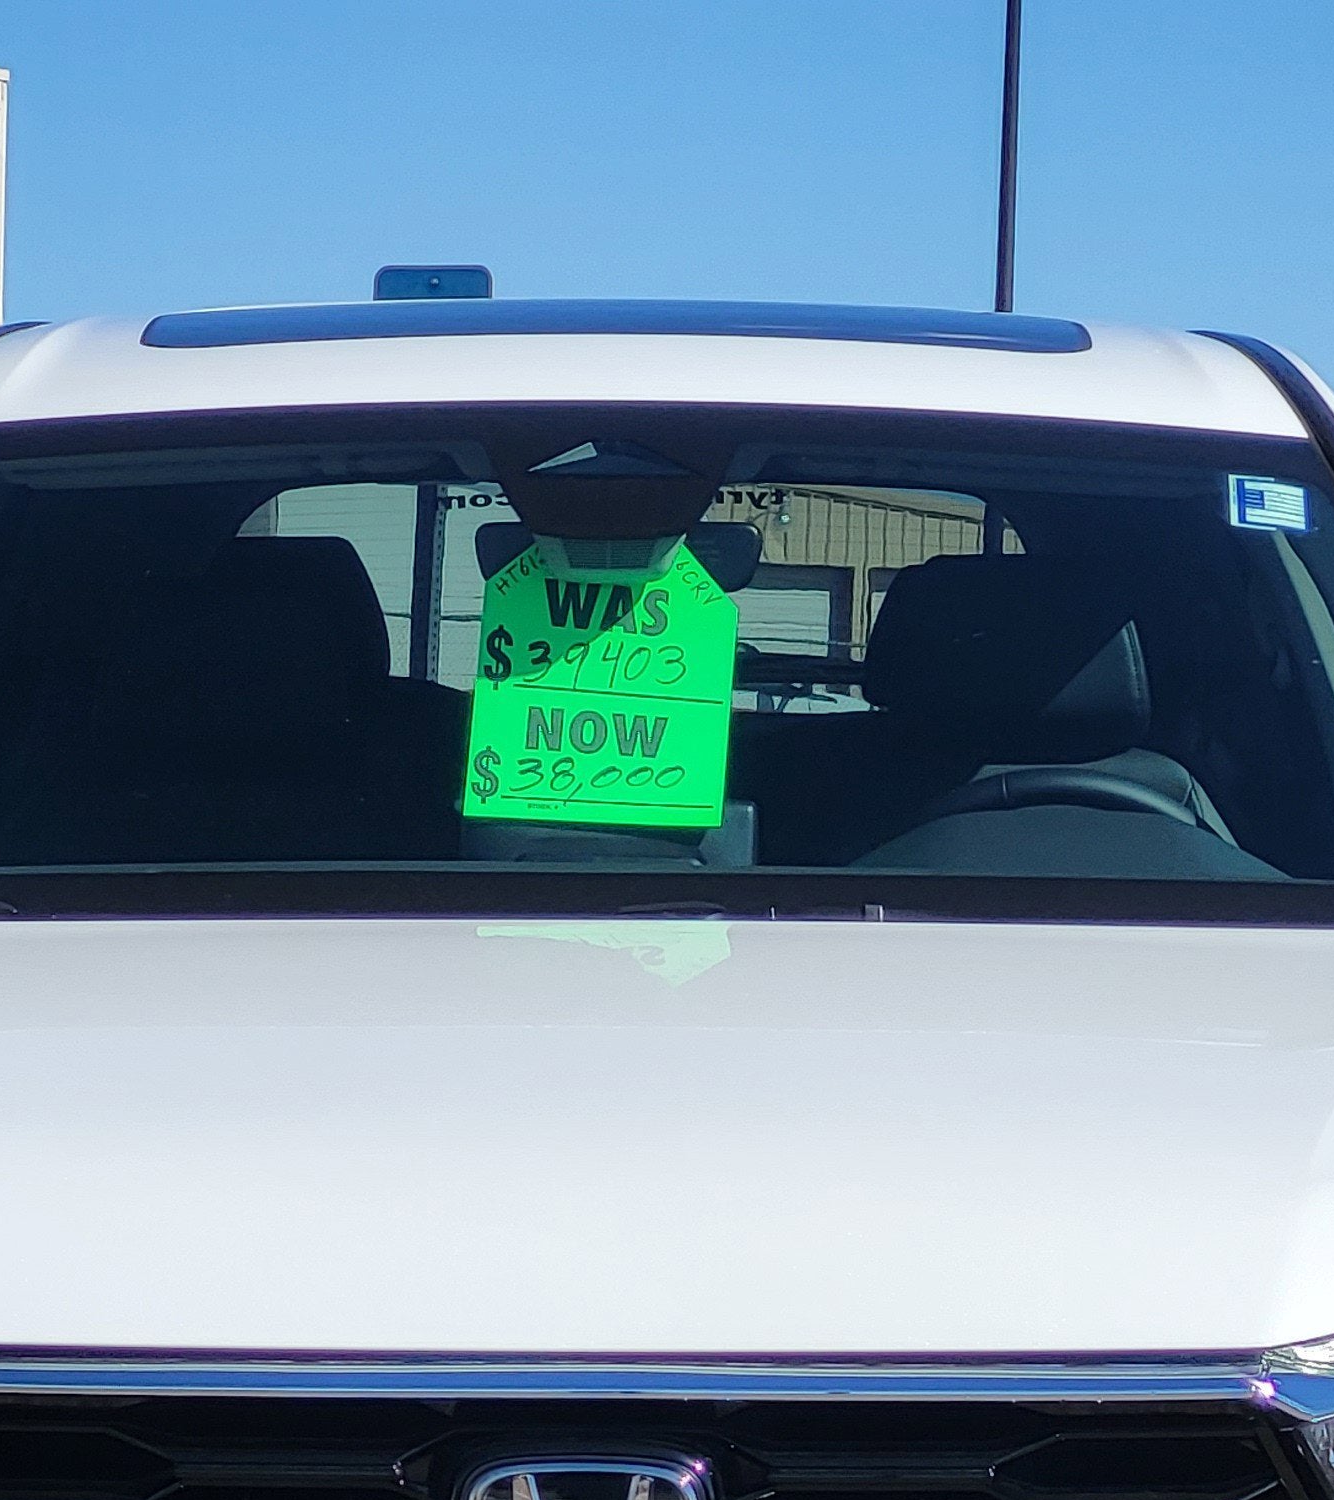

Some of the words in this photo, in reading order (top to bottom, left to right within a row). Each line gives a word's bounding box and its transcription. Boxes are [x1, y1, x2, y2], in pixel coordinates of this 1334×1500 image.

[544, 577, 670, 637] WAS
[524, 705, 669, 759] NOW
[509, 757, 686, 807] 38,000
